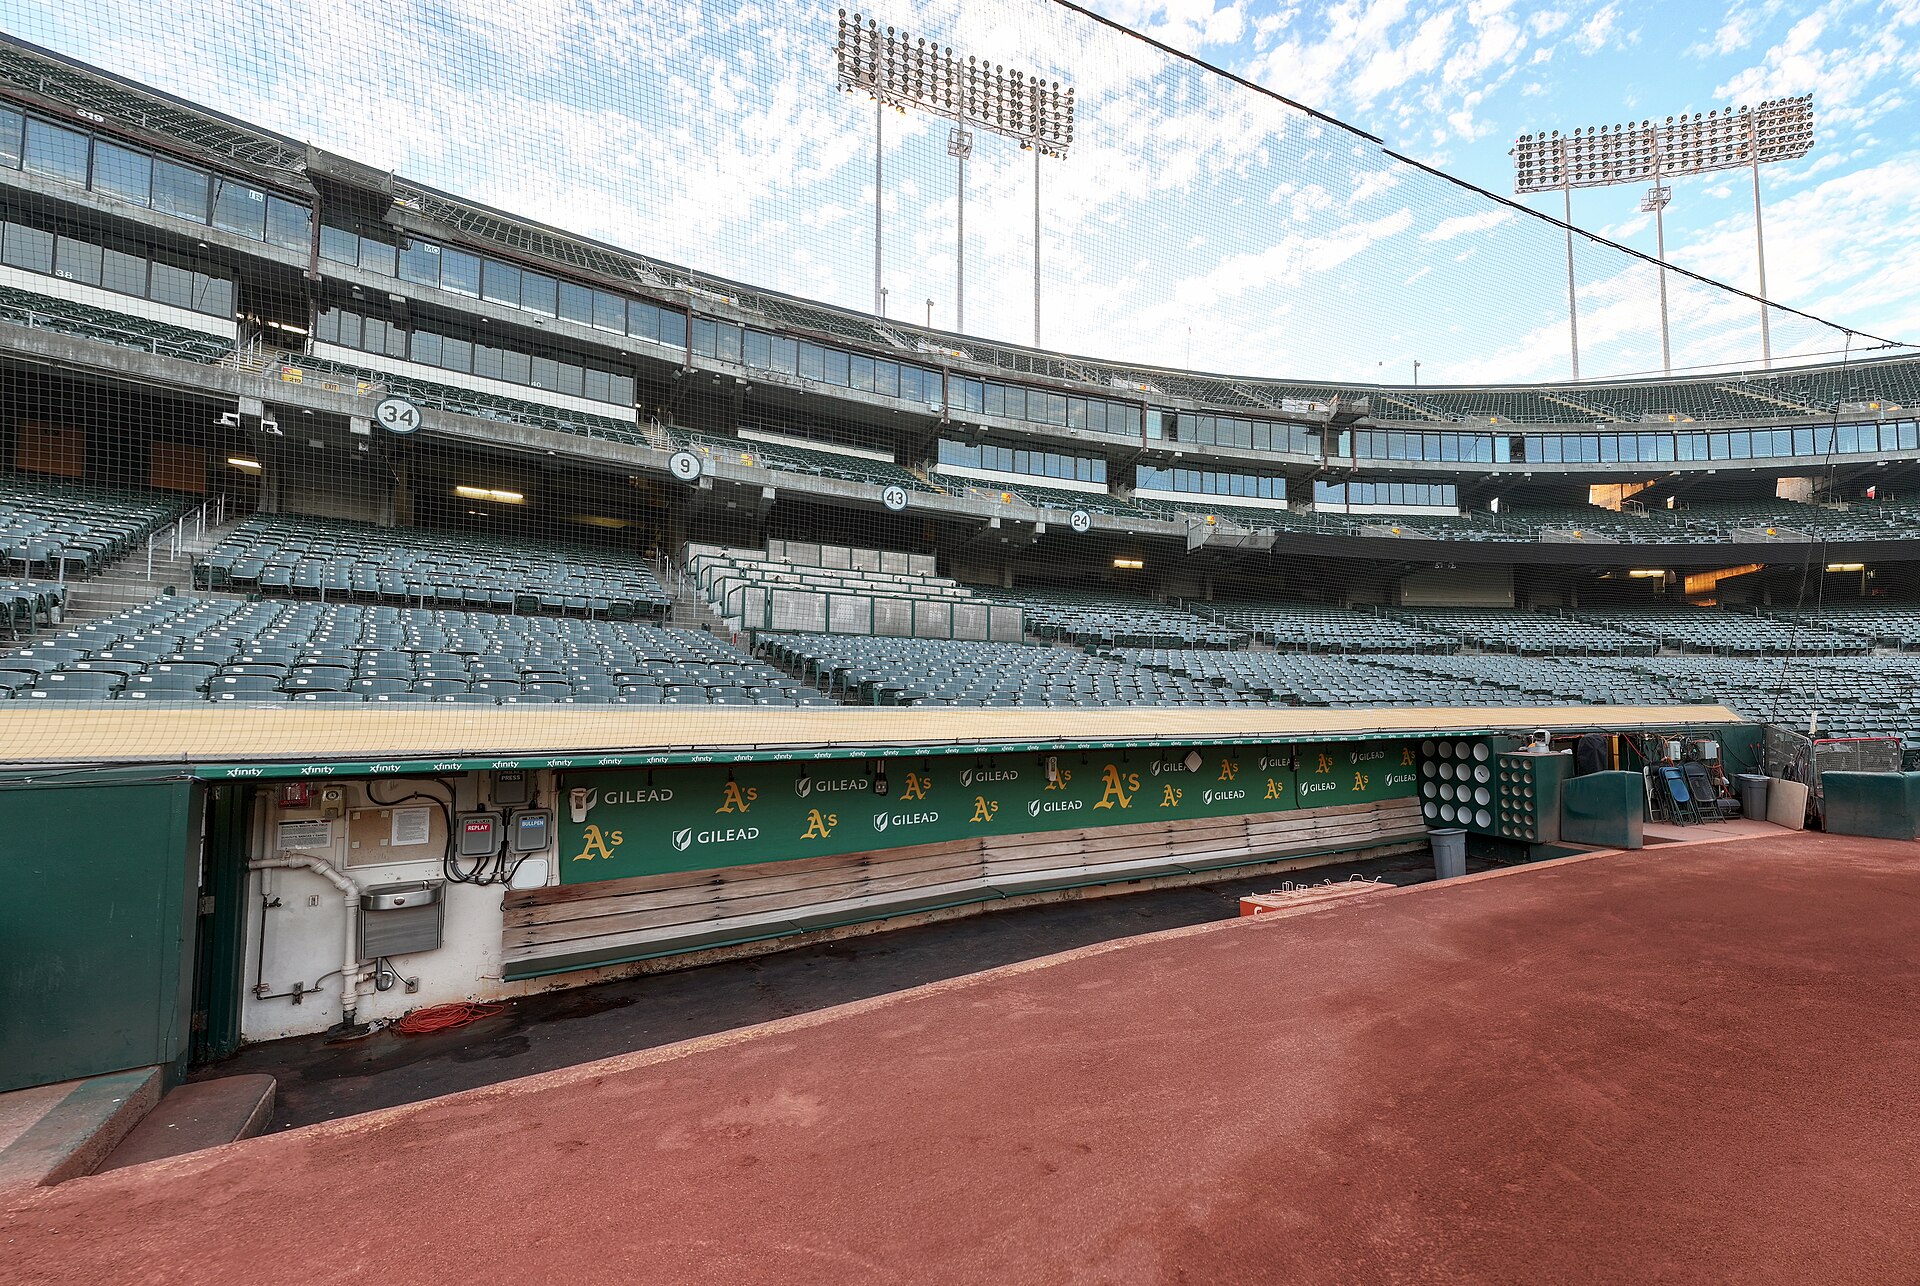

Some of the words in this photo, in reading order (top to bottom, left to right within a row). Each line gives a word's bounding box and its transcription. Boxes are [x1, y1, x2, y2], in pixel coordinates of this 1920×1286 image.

[383, 405, 414, 427] 34
[680, 458, 691, 474] 9
[886, 491, 904, 506] 43
[1073, 515, 1088, 528] 24
[547, 758, 573, 767] xfinity
[598, 757, 622, 765] xfinity
[1358, 751, 1385, 761] GILEAD
[301, 765, 336, 775] xfinity
[369, 764, 401, 773] xfinity
[433, 762, 463, 770] xfinity
[492, 761, 519, 769] xfinity
[226, 767, 264, 777] xfinity
[976, 769, 1019, 782] GILEAD
[1393, 773, 1417, 783] GILEAD
[815, 779, 869, 793] GILEAD
[900, 772, 932, 801] A's
[1093, 763, 1141, 810] A's
[1309, 782, 1337, 793] GILEAD
[604, 788, 674, 805] GILEAD
[715, 781, 758, 814] A's
[1214, 789, 1246, 801] GILEAD
[968, 795, 999, 823] A's
[1043, 800, 1083, 813] GILEAD
[521, 820, 545, 828] BULLPEN
[800, 808, 838, 839] A's
[892, 812, 939, 827] GILEAD
[467, 824, 489, 832] REPLAY
[697, 827, 760, 844] GILEAD
[572, 824, 624, 862] A's
